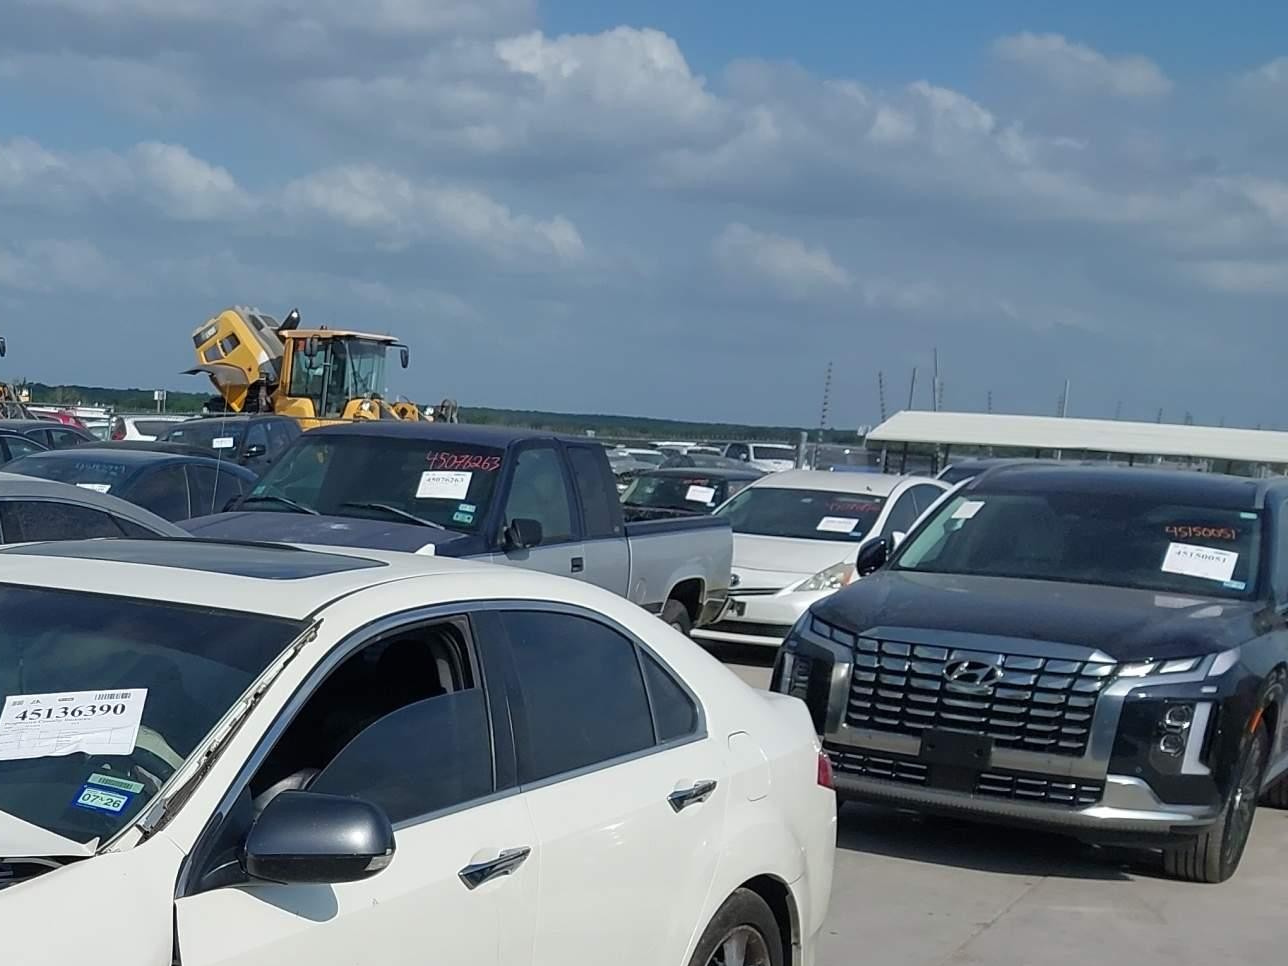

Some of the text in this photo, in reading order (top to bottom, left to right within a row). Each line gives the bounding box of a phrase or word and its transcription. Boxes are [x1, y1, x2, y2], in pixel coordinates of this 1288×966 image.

[426, 451, 501, 471] 45076263
[1165, 526, 1236, 539] 45150051
[15, 703, 126, 721] 45136390
